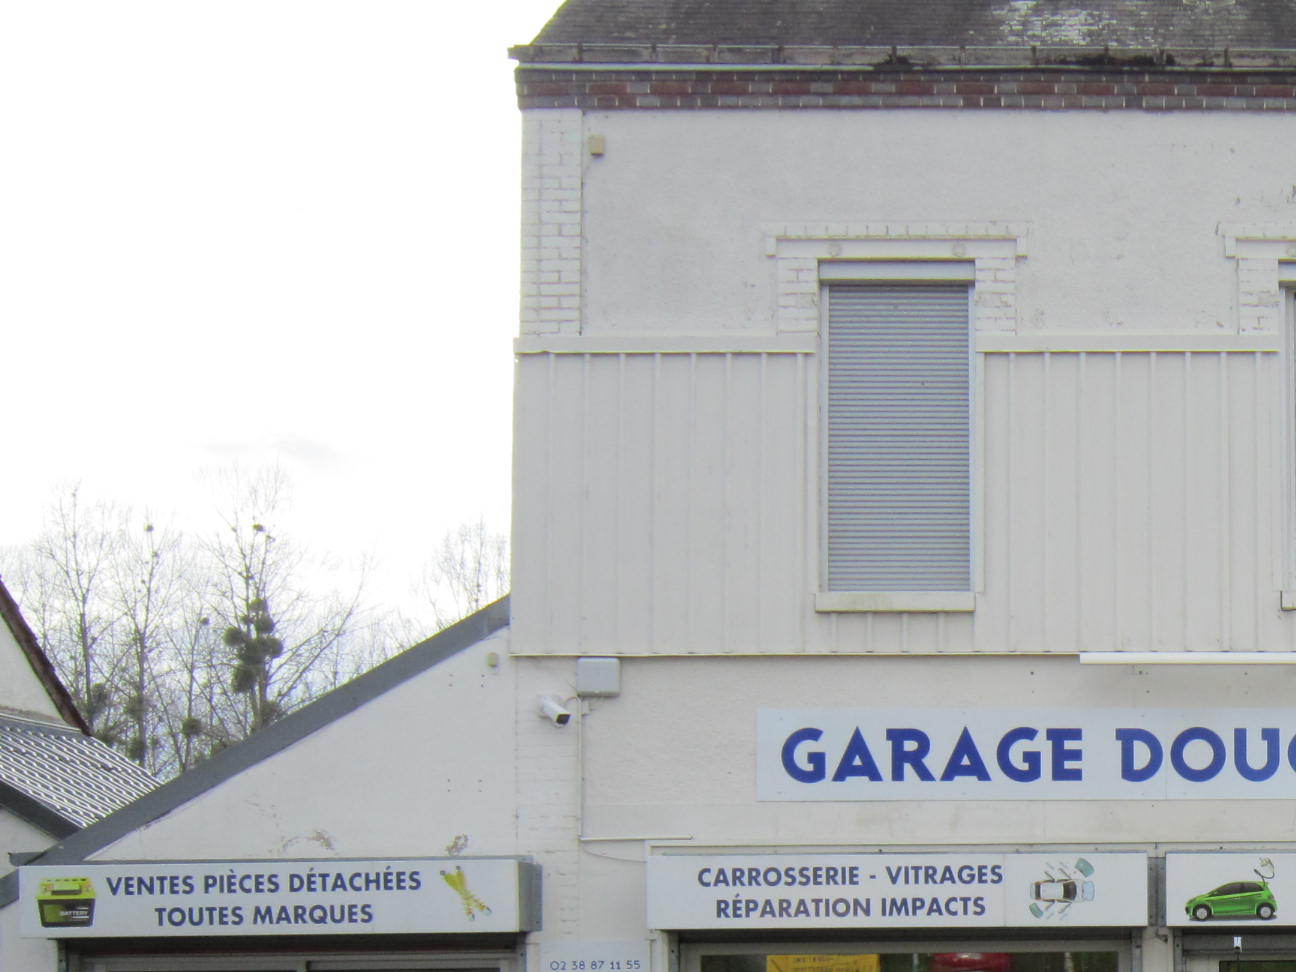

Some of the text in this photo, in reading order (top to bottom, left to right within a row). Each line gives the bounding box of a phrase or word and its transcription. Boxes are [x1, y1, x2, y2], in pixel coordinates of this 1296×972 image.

[781, 726, 1083, 784] GARAGE
[106, 866, 422, 896] VENTES PIÈCES DÉTACHÉES
[697, 867, 860, 887] CARROSSERIE
[885, 864, 1003, 885] VITRAGES
[154, 903, 373, 927] TOUTES MARQUES
[716, 893, 986, 918] RÉPARATION IMPACTS
[571, 960, 586, 970] 38
[590, 960, 605, 970] 87
[609, 960, 622, 970] 11
[626, 959, 641, 970] 55
